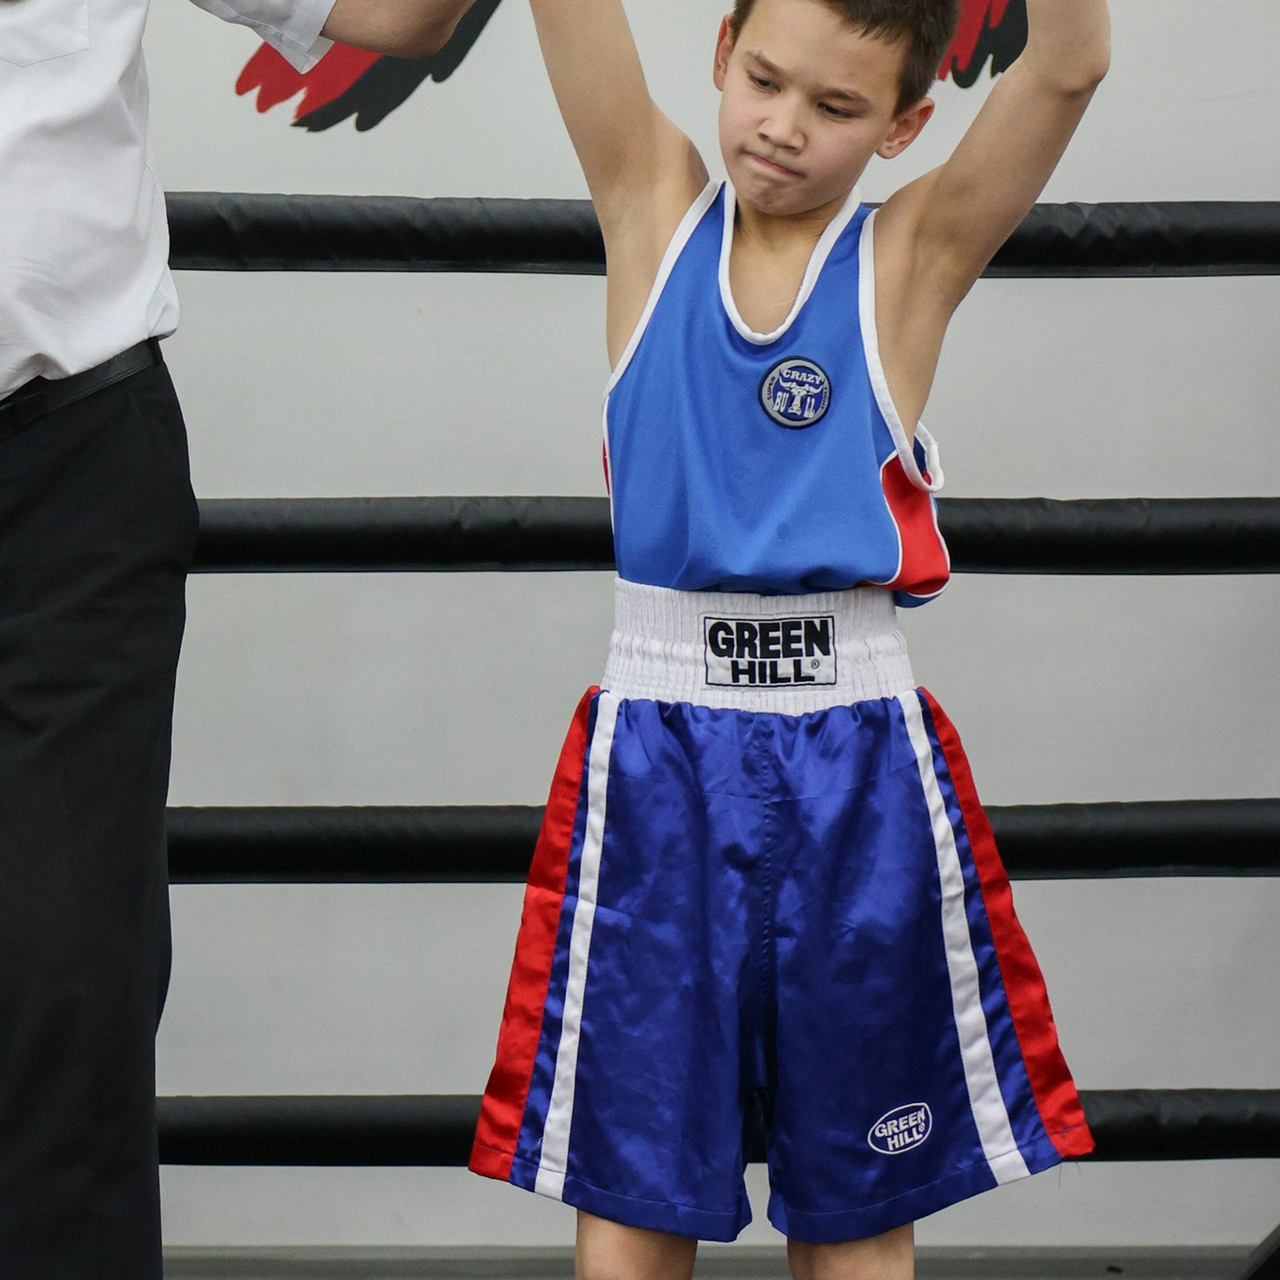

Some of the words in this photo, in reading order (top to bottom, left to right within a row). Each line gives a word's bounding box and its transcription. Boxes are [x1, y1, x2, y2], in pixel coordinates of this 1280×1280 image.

[766, 376, 776, 401] SUPER
[782, 369, 824, 385] CRAZY
[708, 620, 831, 659] GREEN
[731, 659, 815, 684] HILL
[874, 1107, 926, 1138] GREEN
[886, 1127, 923, 1151] HILL
